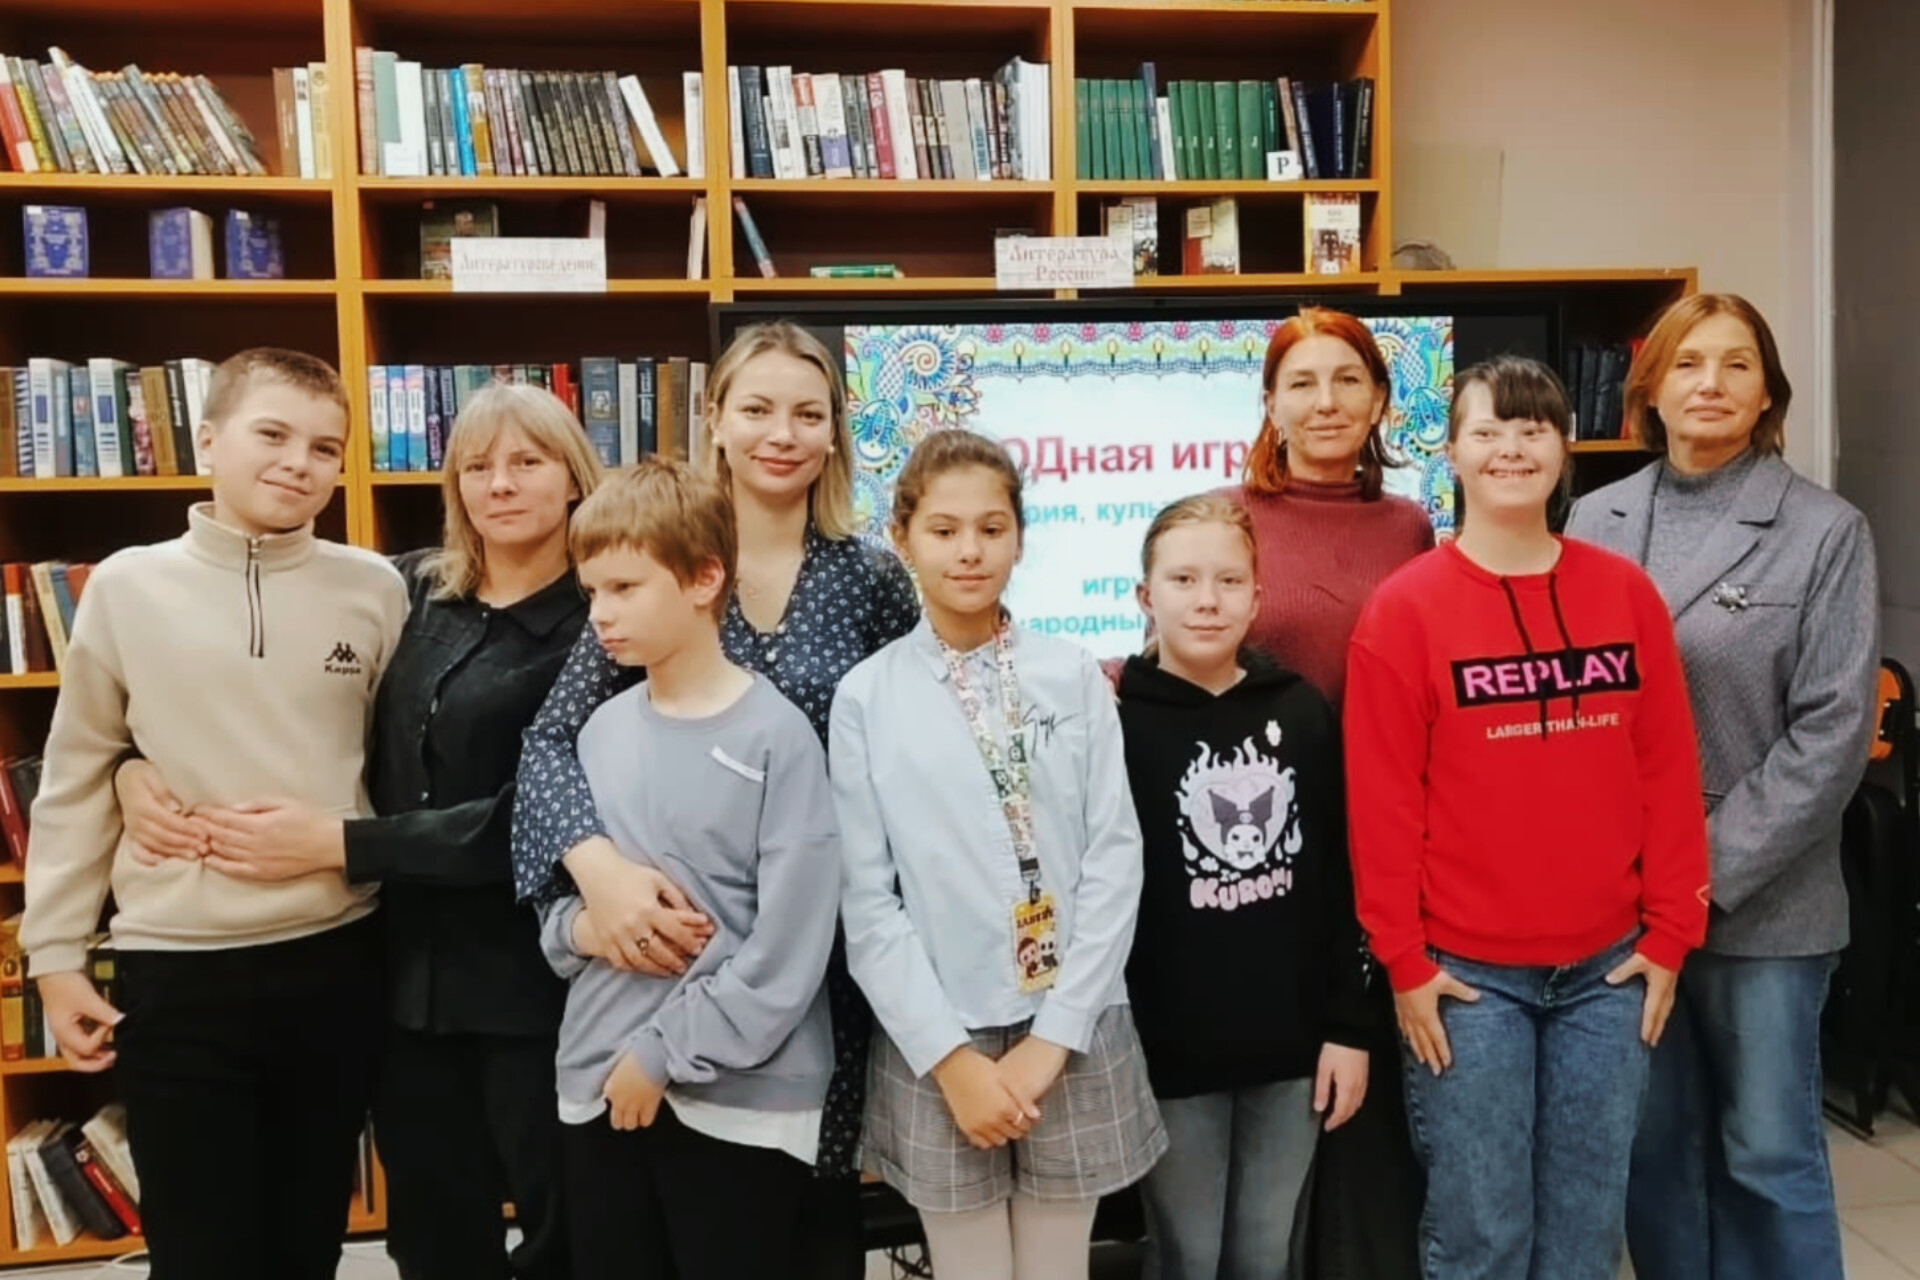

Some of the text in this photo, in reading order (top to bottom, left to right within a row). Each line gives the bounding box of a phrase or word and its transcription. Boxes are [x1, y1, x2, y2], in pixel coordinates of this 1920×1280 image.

[1097, 501, 1167, 525] куль
[1082, 575, 1137, 600] игр
[1019, 613, 1142, 636] ародны
[324, 664, 361, 675] Kappa
[1462, 650, 1630, 699] REPLAY
